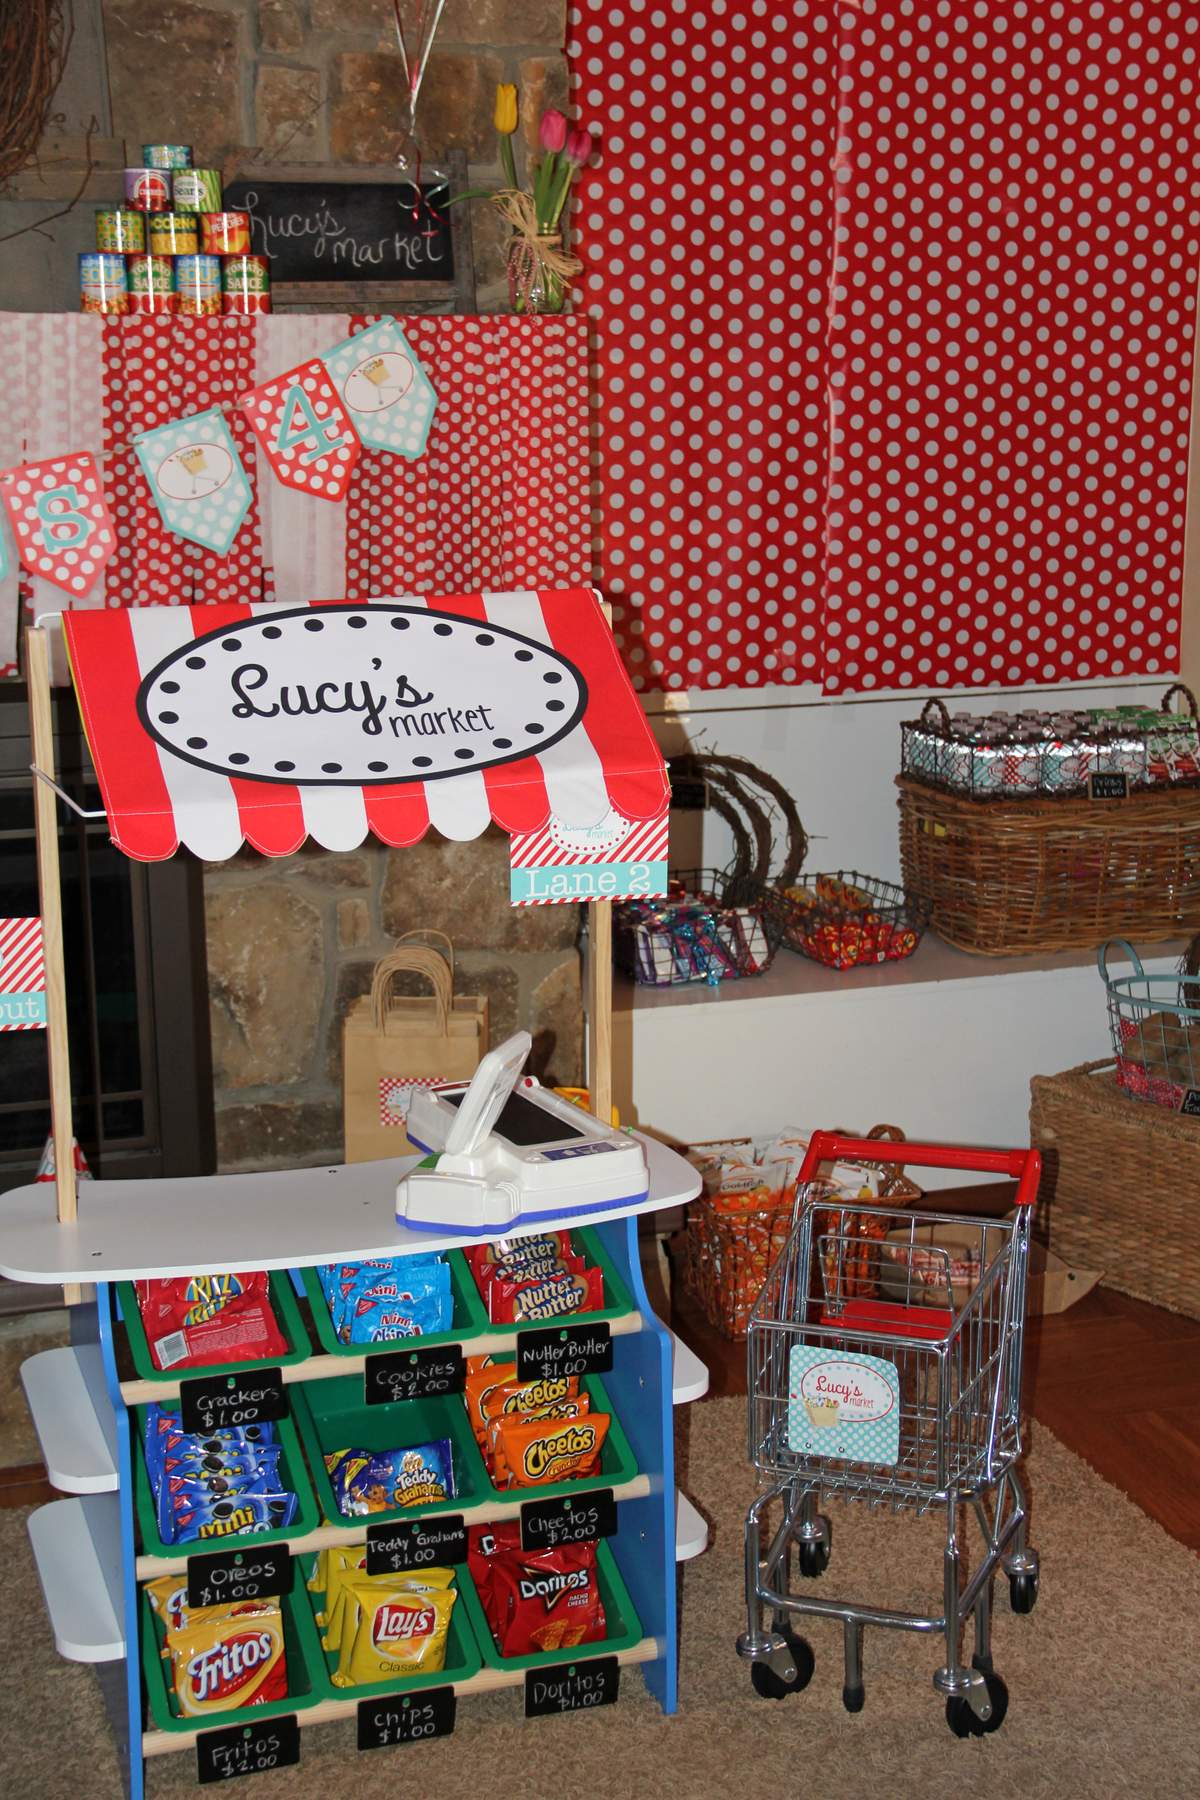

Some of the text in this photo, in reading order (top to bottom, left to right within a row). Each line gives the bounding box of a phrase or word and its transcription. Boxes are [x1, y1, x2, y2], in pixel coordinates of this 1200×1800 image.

[232, 191, 346, 259] Lucy's
[334, 219, 444, 269] market
[227, 277, 264, 289] SACE
[276, 385, 346, 462] 4
[37, 486, 89, 552] S
[231, 657, 434, 735] Lucy's
[389, 704, 495, 738] market
[525, 864, 650, 898] Lane 2
[0, 997, 40, 1020] ut
[518, 1277, 572, 1313] Nutter
[527, 1289, 582, 1321] Butter
[541, 1359, 587, 1378] $1.00
[196, 1388, 280, 1410] Crackers
[391, 1380, 449, 1400] $2.00
[816, 1376, 863, 1403] Lucy's
[202, 1408, 258, 1428] $1.00
[525, 1428, 596, 1477] Cheetos
[398, 1469, 436, 1488] Teddy
[394, 1483, 444, 1505] Grahams
[528, 1507, 598, 1533] Cheetos
[368, 1537, 409, 1553] Teddy
[391, 1549, 435, 1569] $1.00
[210, 1561, 276, 1584] Oreos
[200, 1583, 259, 1606] $1.00
[567, 1599, 589, 1607] CHEESE
[376, 1607, 433, 1641] Lay's
[188, 1632, 271, 1700] Fritos
[379, 1660, 425, 1673] Classic
[534, 1672, 605, 1704] Doritos
[212, 1735, 280, 1767] Fritos
[221, 1754, 277, 1776] $2.00
